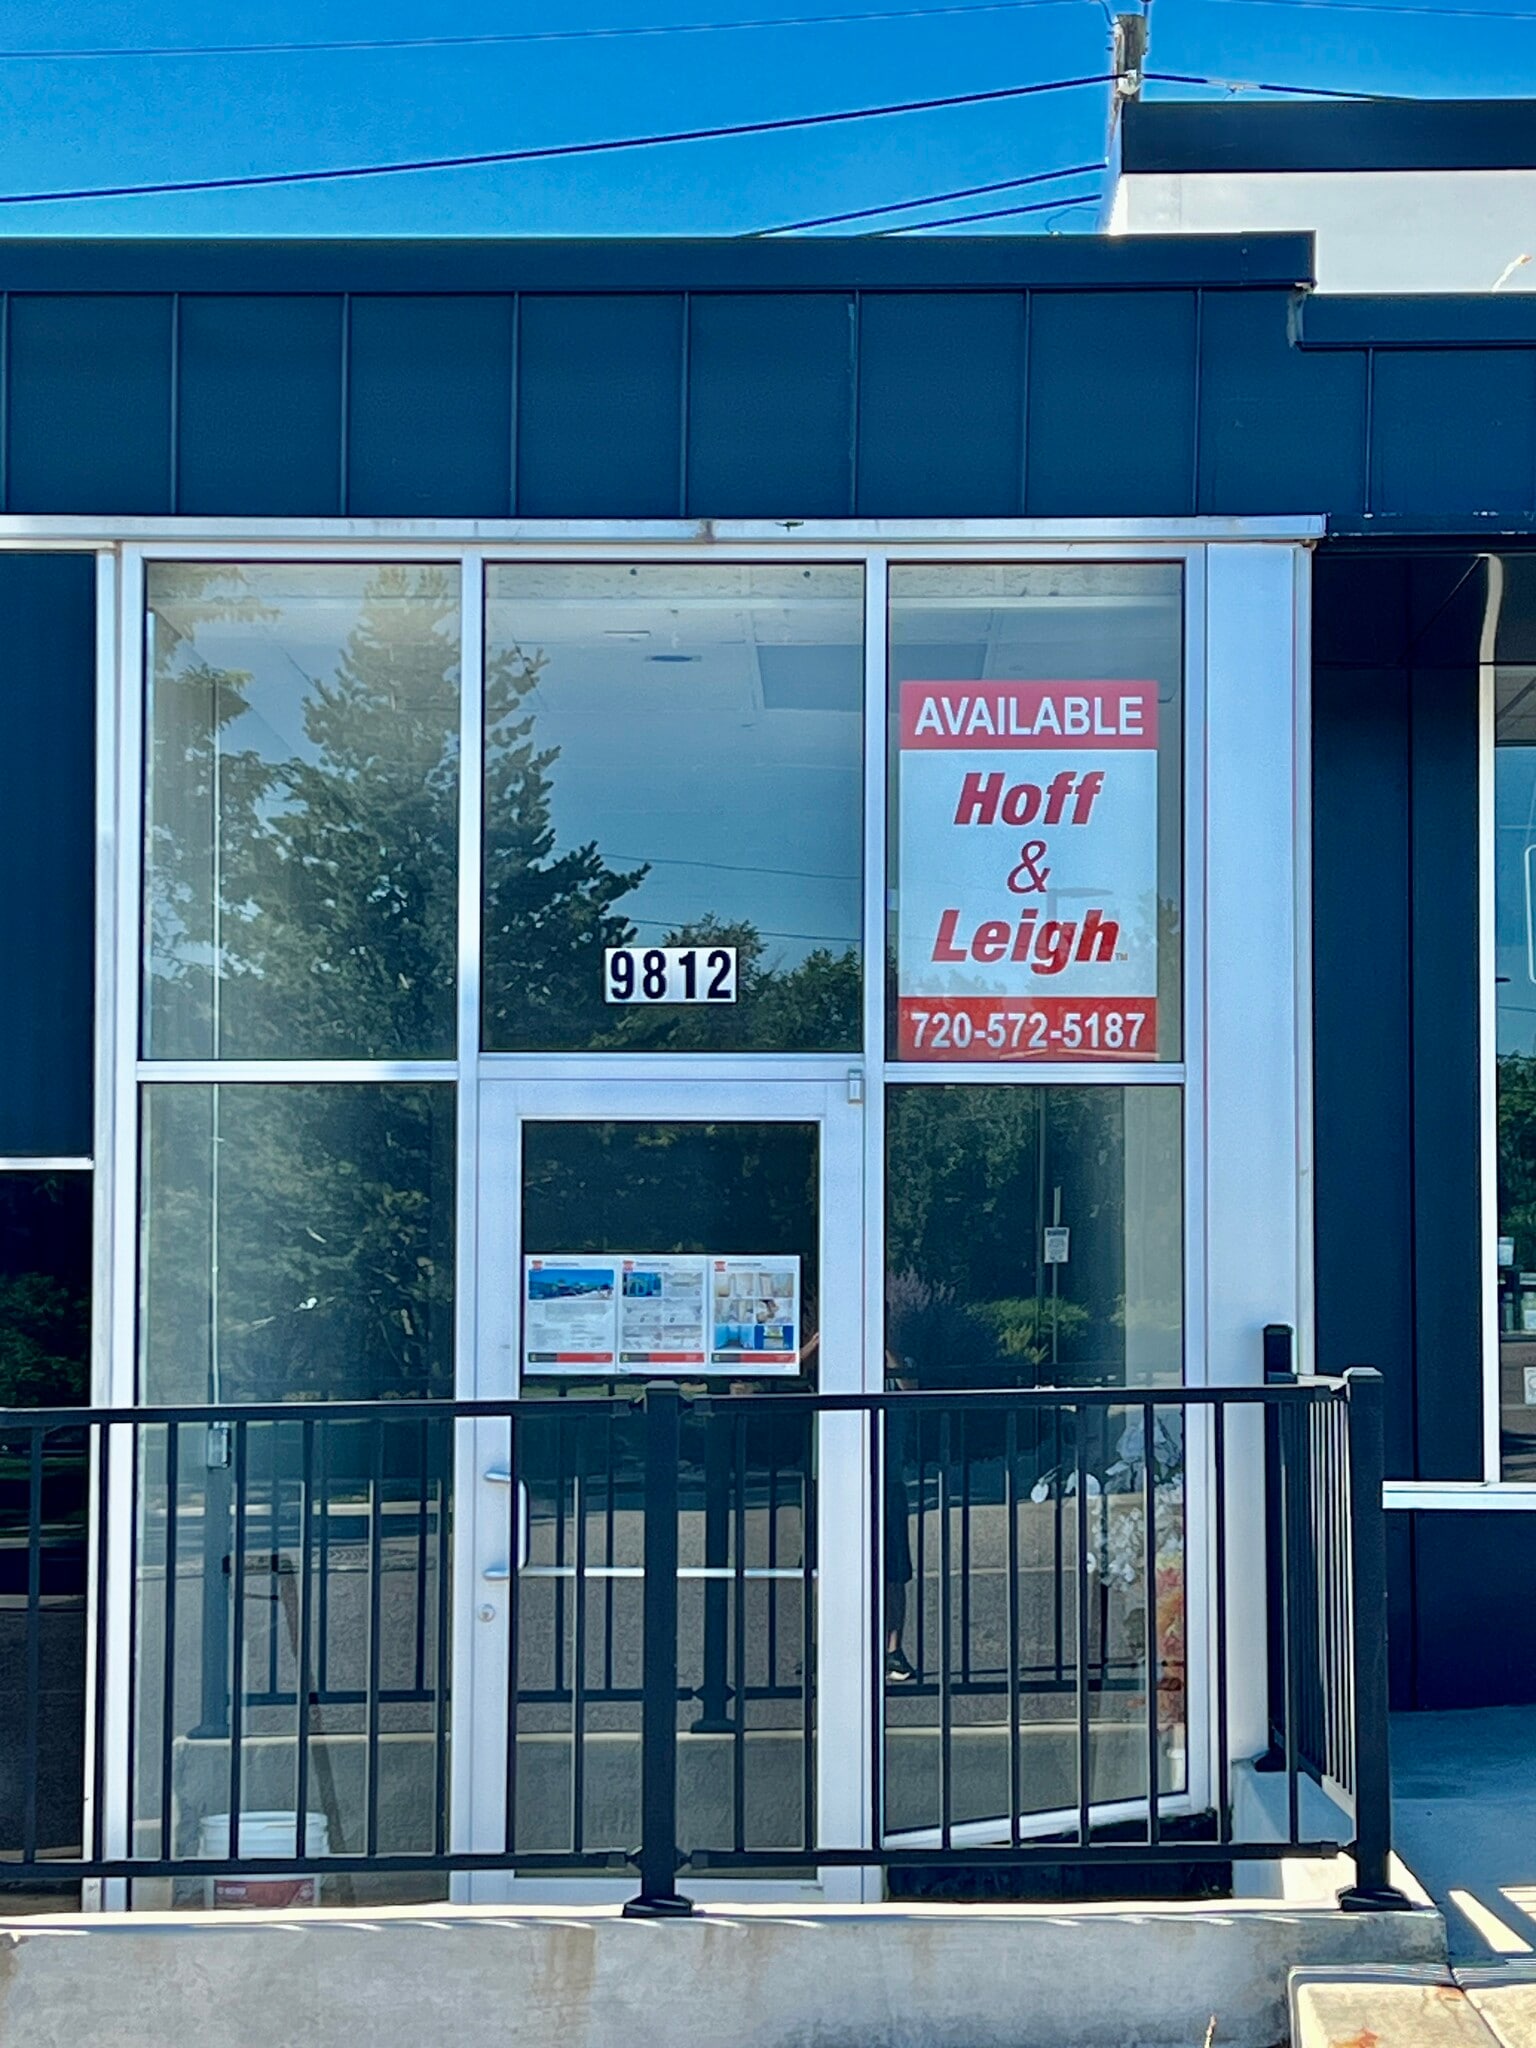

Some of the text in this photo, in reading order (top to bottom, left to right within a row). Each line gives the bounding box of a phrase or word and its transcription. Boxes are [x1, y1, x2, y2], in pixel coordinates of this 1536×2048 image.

[914, 697, 1144, 736] AVAILABLE
[953, 772, 1105, 826] Hoff
[1006, 840, 1051, 894] &
[931, 909, 1119, 974] Leigh
[610, 949, 732, 1000] 9812
[910, 1013, 1146, 1049] 720-572-5187
